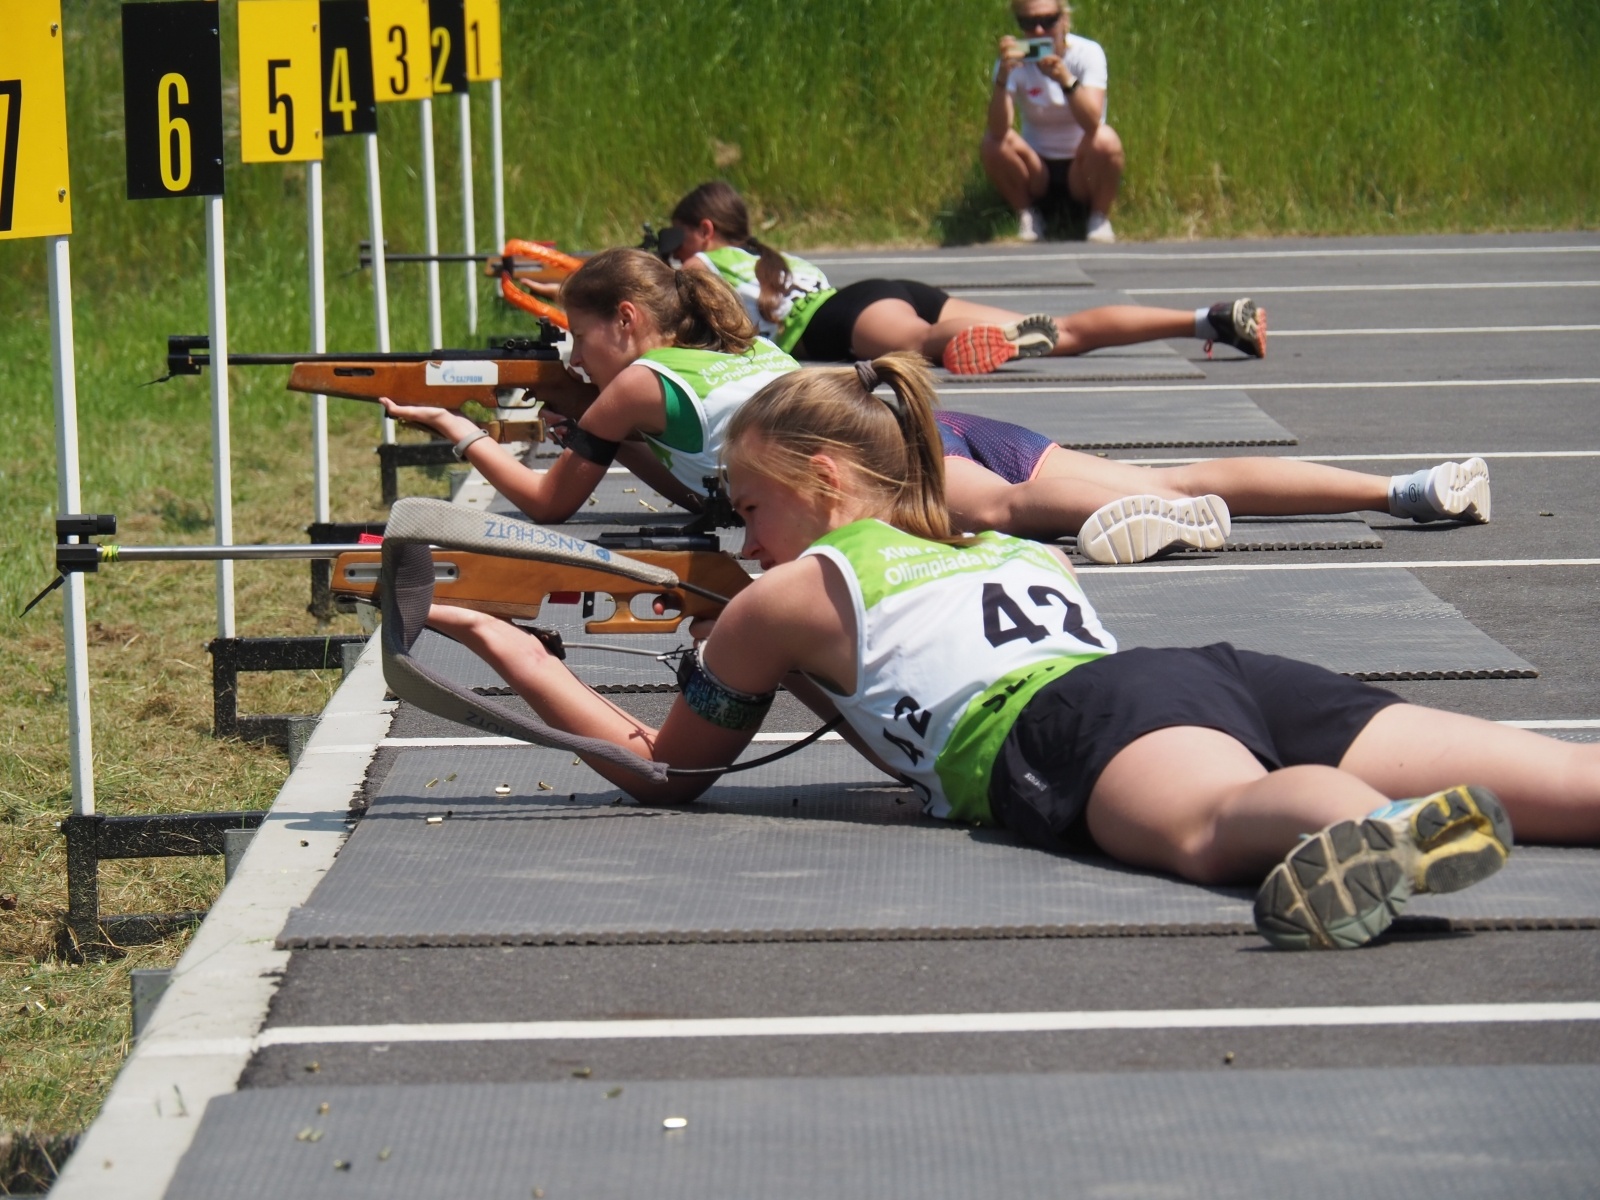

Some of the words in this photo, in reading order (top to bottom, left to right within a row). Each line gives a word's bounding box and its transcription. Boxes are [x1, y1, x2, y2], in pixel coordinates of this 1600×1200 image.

[388, 25, 409, 95] 3
[431, 26, 453, 93] 2
[470, 20, 481, 76] 1
[267, 59, 294, 156] 5
[329, 47, 357, 132] 4
[0, 79, 22, 231] 7
[157, 72, 191, 191] 6
[456, 375, 483, 383] GAZPROM
[884, 551, 983, 586] Olimpiada
[981, 582, 1106, 649] 42
